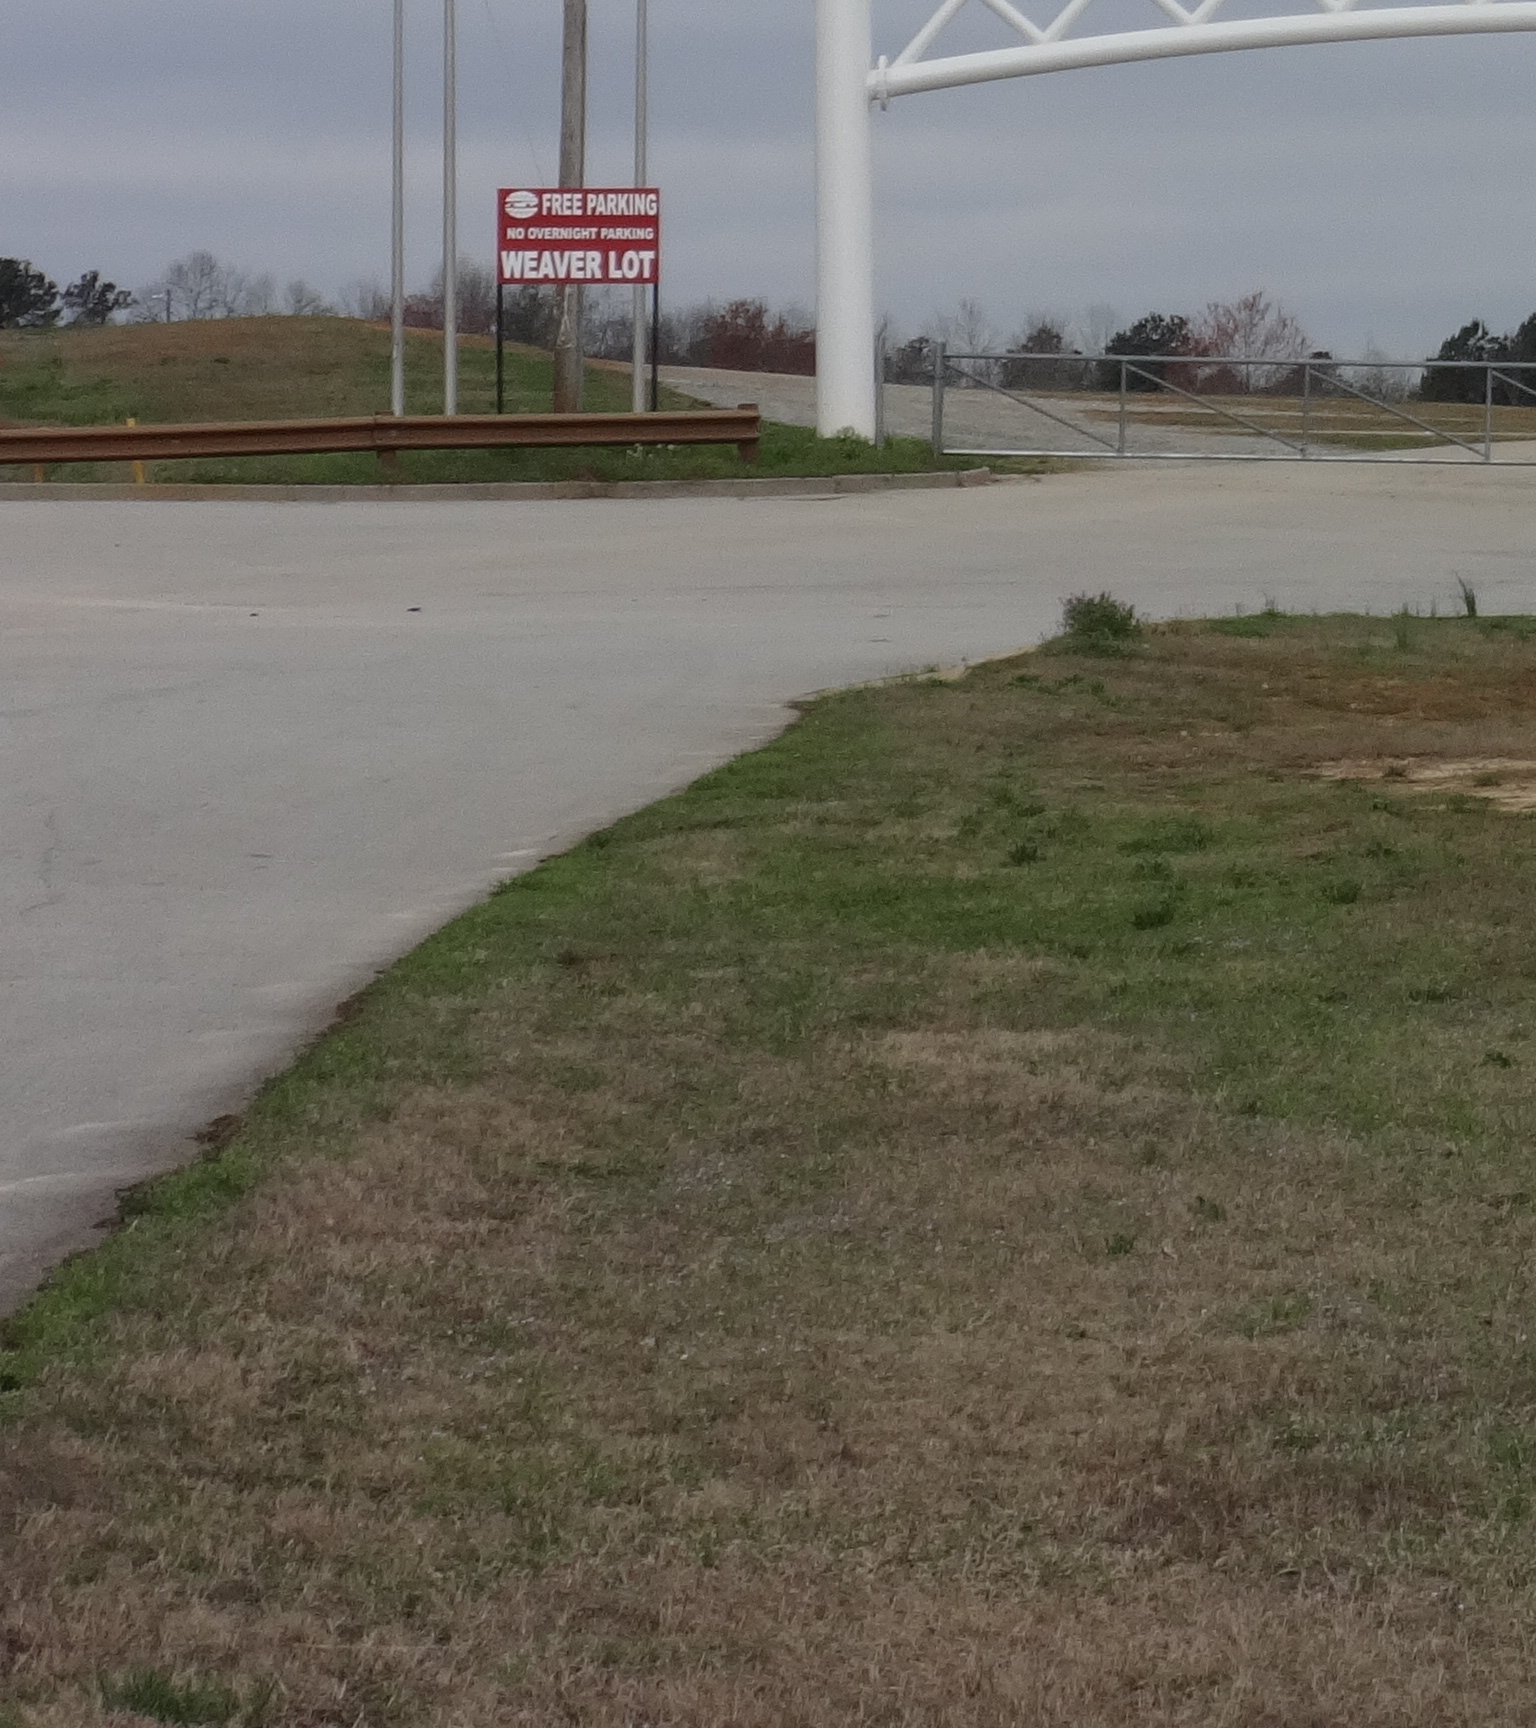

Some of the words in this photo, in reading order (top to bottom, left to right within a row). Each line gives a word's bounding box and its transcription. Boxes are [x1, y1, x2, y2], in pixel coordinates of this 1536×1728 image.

[542, 193, 583, 216] FREE
[587, 193, 657, 216] PARKING
[506, 227, 525, 240] NO
[527, 227, 598, 240] OVERNIGHT
[601, 227, 654, 240] PARKING
[501, 251, 602, 279] WEAVER
[608, 251, 655, 279] LOT
